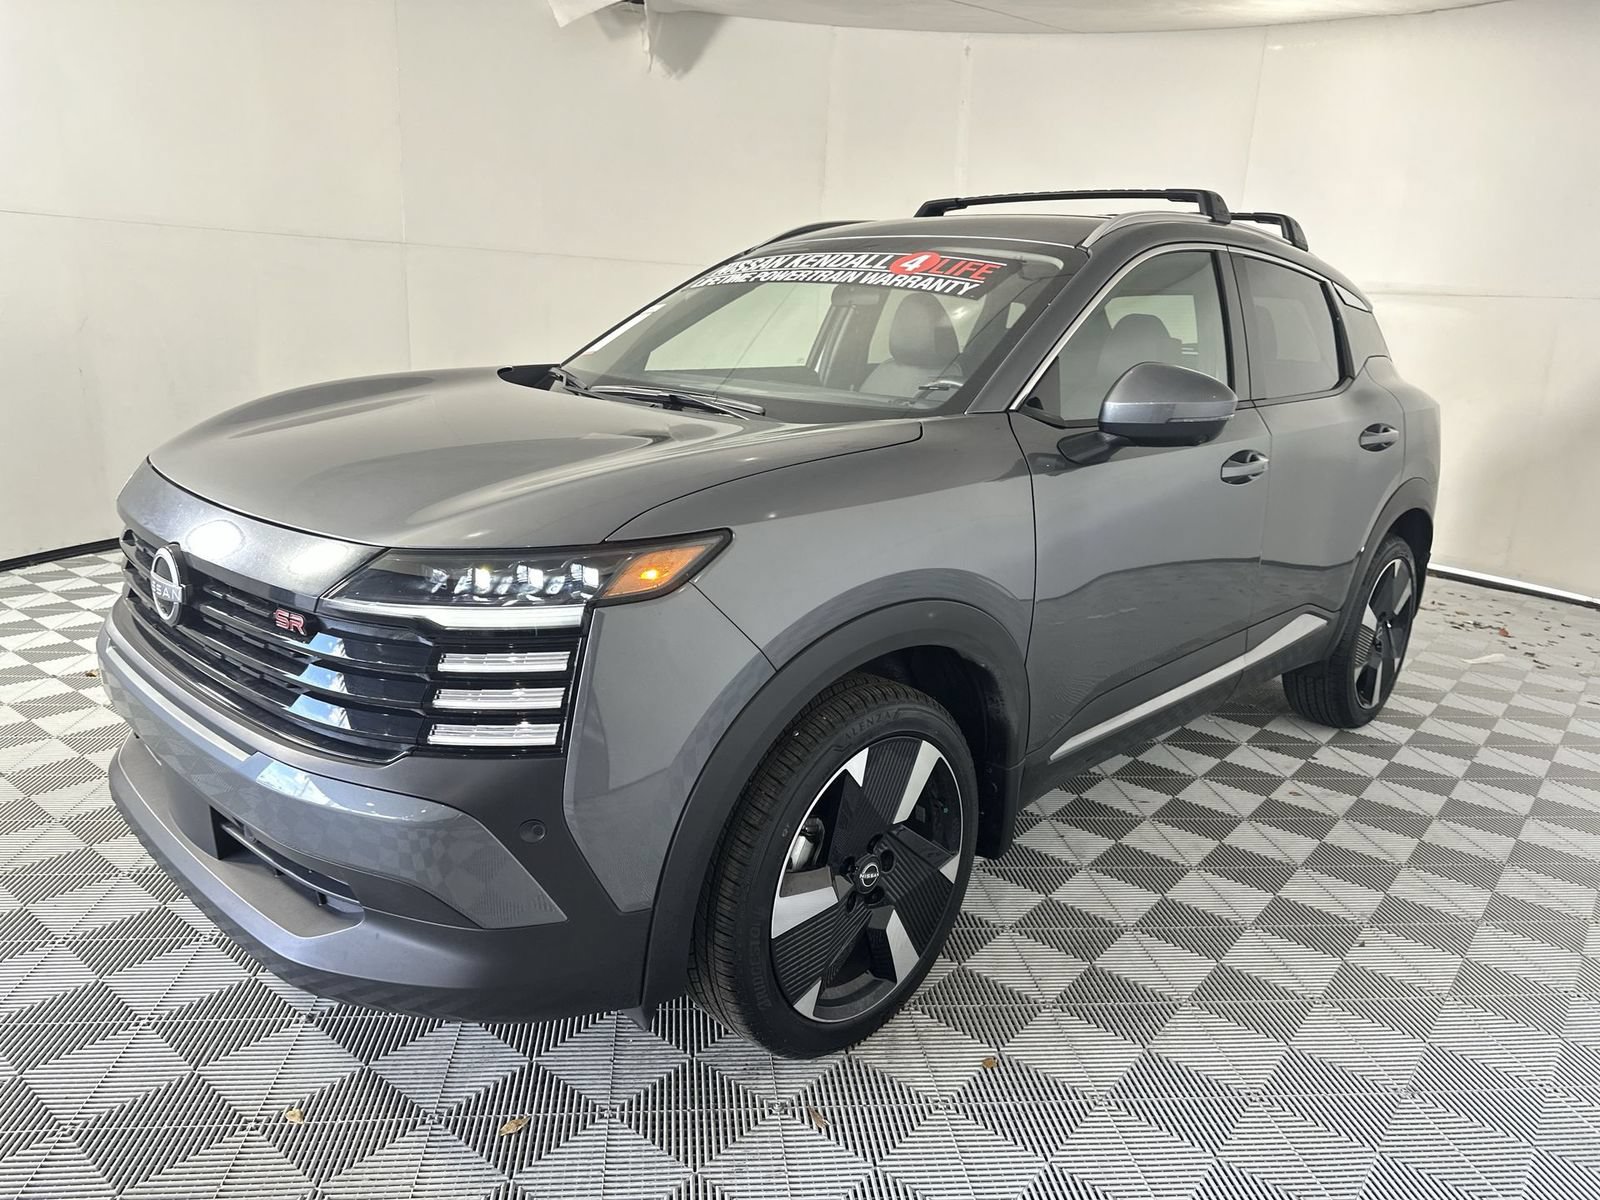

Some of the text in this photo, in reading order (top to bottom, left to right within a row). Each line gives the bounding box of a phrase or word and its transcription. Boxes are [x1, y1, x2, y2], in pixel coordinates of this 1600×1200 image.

[788, 254, 890, 269] KENDALL
[900, 255, 930, 271] 4
[928, 258, 1001, 280] LIFE
[750, 270, 861, 283] POWERTRAIN
[861, 272, 980, 295] WARRANTY
[273, 609, 307, 636] SR
